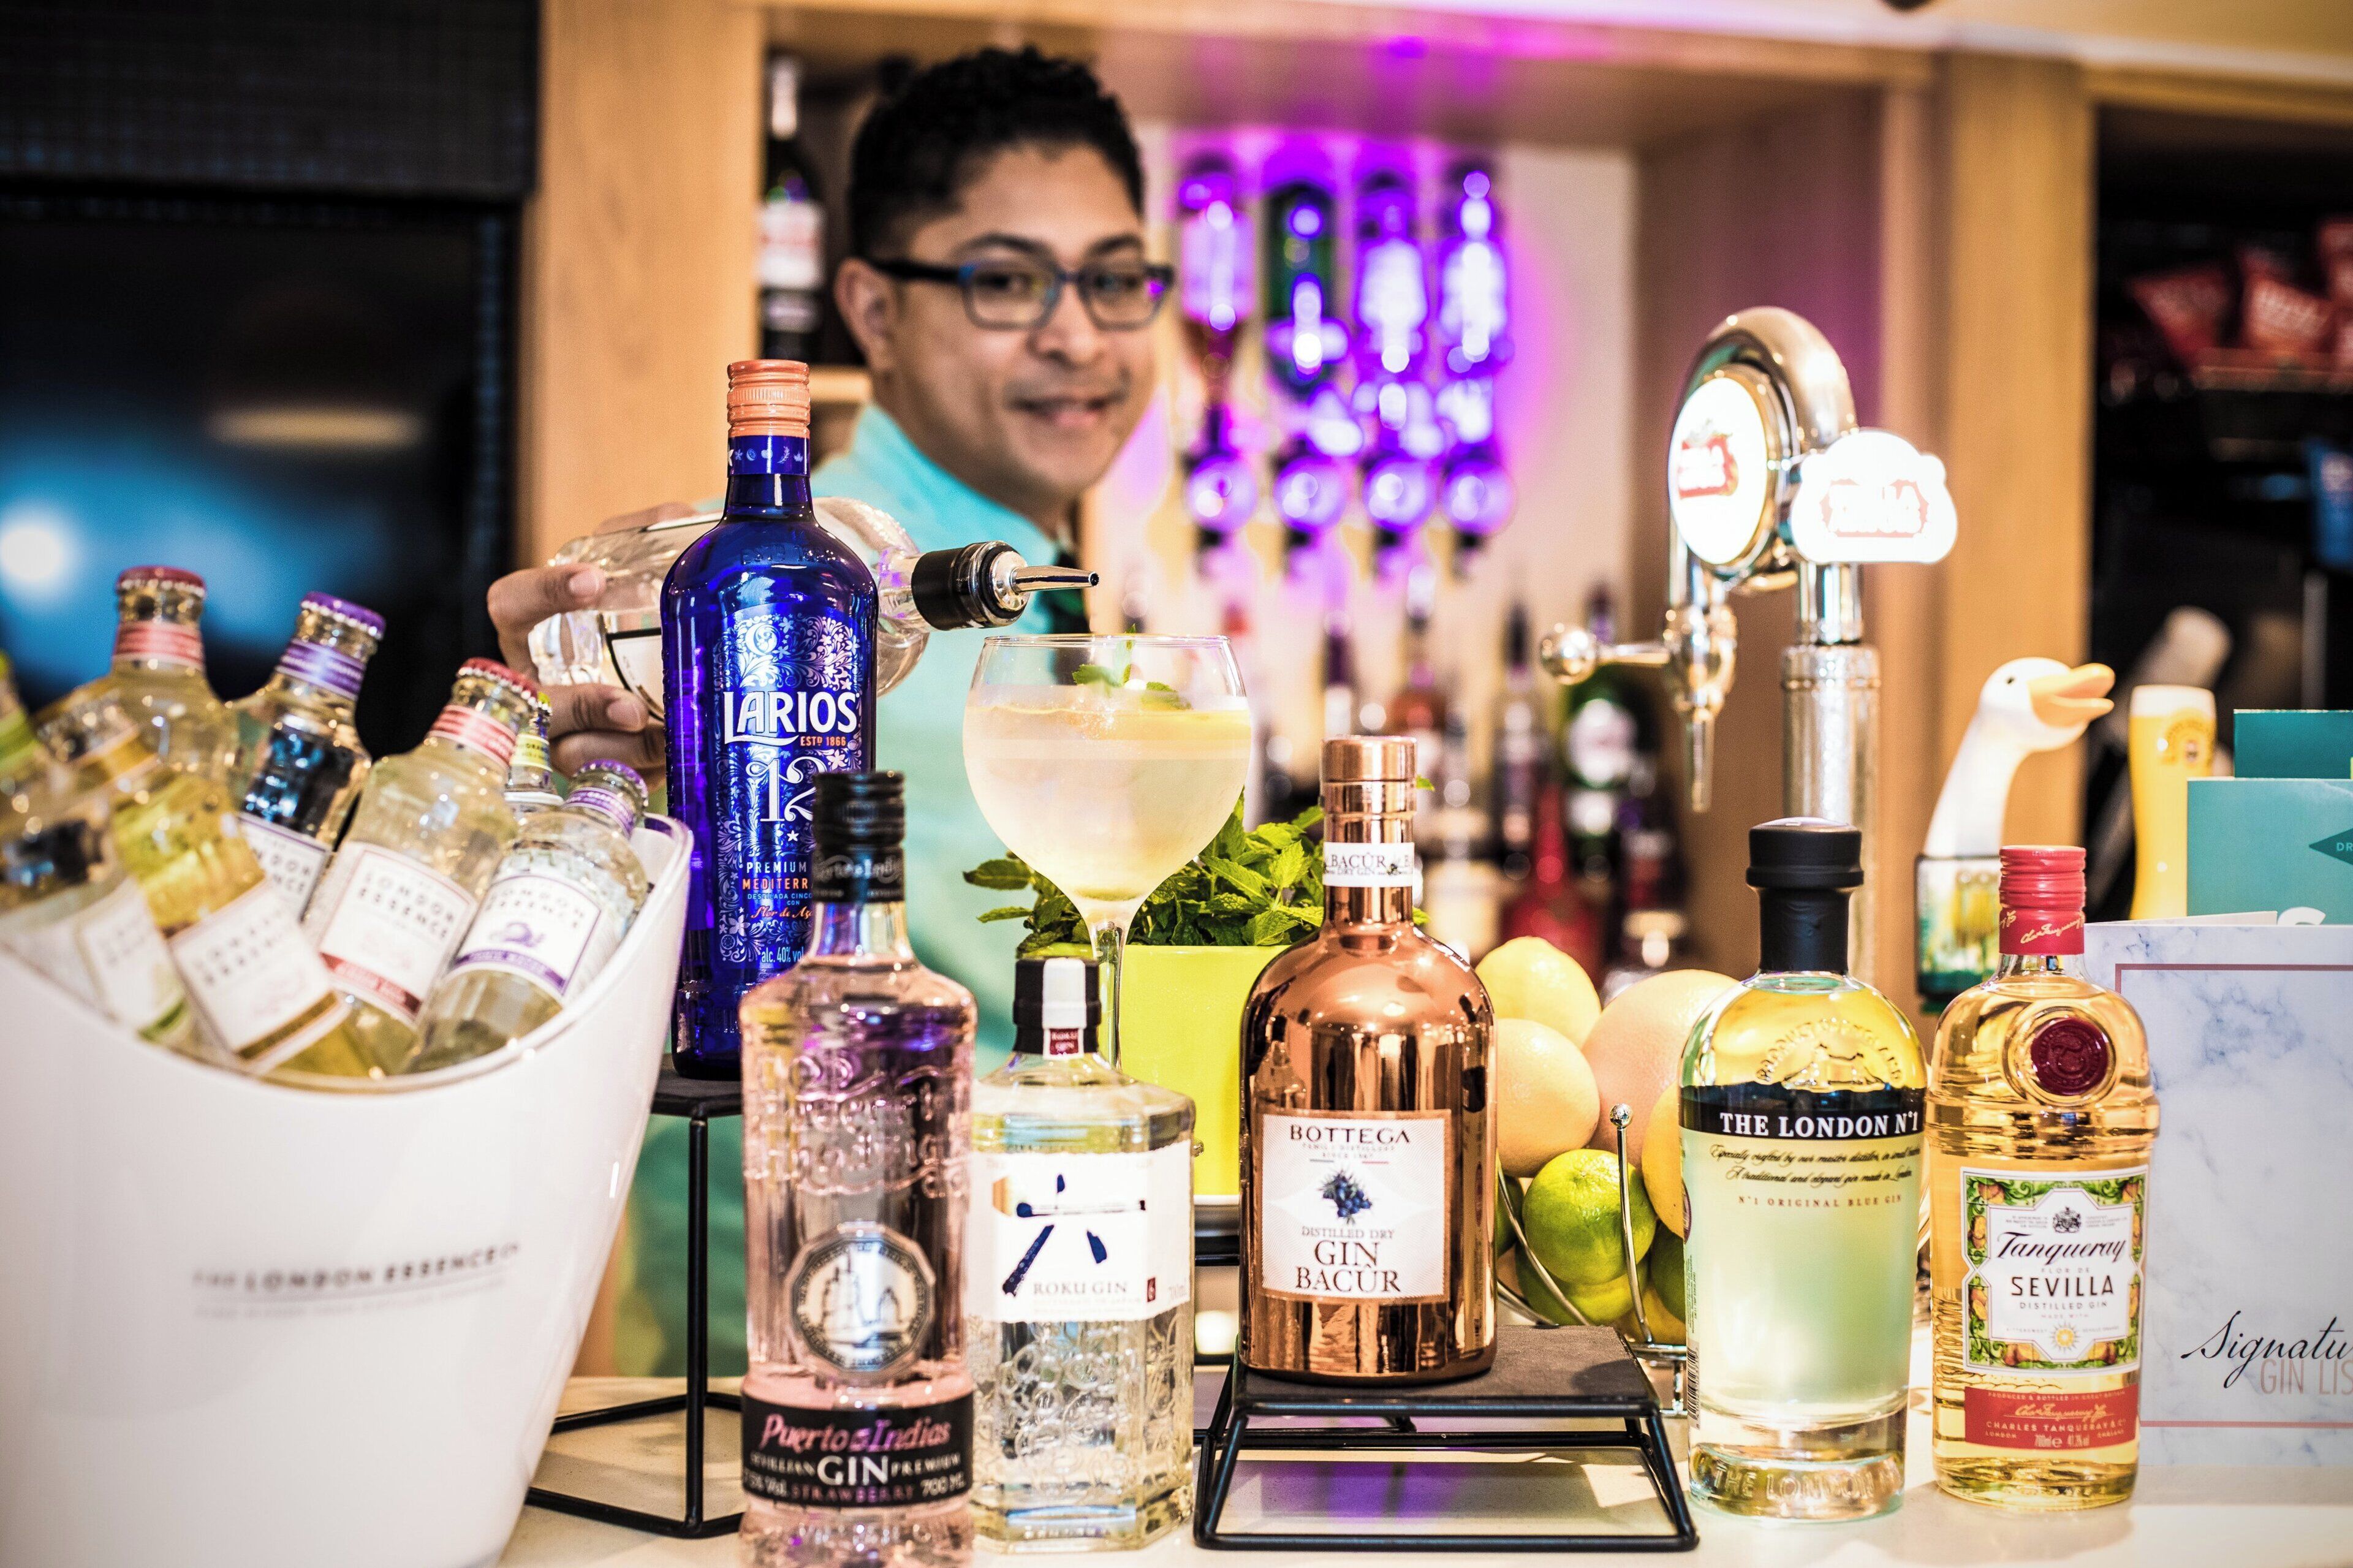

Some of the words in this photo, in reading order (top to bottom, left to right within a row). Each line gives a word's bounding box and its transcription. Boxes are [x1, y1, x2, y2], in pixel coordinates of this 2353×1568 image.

[723, 691, 858, 746] LARIOS
[826, 737, 846, 746] 1866
[745, 756, 827, 822] 12
[2336, 842, 2353, 851] DR
[746, 861, 807, 874] PREMIUM
[742, 877, 809, 890] MEDITERR
[779, 907, 790, 917] de
[792, 906, 812, 919] Az
[762, 951, 775, 963] alc.
[776, 946, 791, 963] 40%
[1289, 1124, 1410, 1145] BOTTEGA
[1719, 1112, 1770, 1136] THE
[1778, 1115, 1889, 1138] LONDON
[1767, 1197, 1840, 1208] ORIGINAL
[1848, 1196, 1878, 1207] BLUE
[1302, 1225, 1364, 1238] DISTILLED
[1370, 1229, 1395, 1239] DRY
[1314, 1240, 1379, 1267] GIN
[1996, 1232, 2127, 1265] Tanqueray
[1034, 1282, 1086, 1295] ROKU
[1092, 1281, 1127, 1293] GIN
[2012, 1275, 2114, 1298] SEVILLA
[2181, 1310, 2353, 1388] Signatu
[2260, 1358, 2304, 1394] GIN
[2319, 1359, 2353, 1395] LIS
[1986, 1422, 2037, 1431] CHARLES
[2043, 1422, 2108, 1432] TANQUERAY
[817, 1455, 888, 1486] GIN
